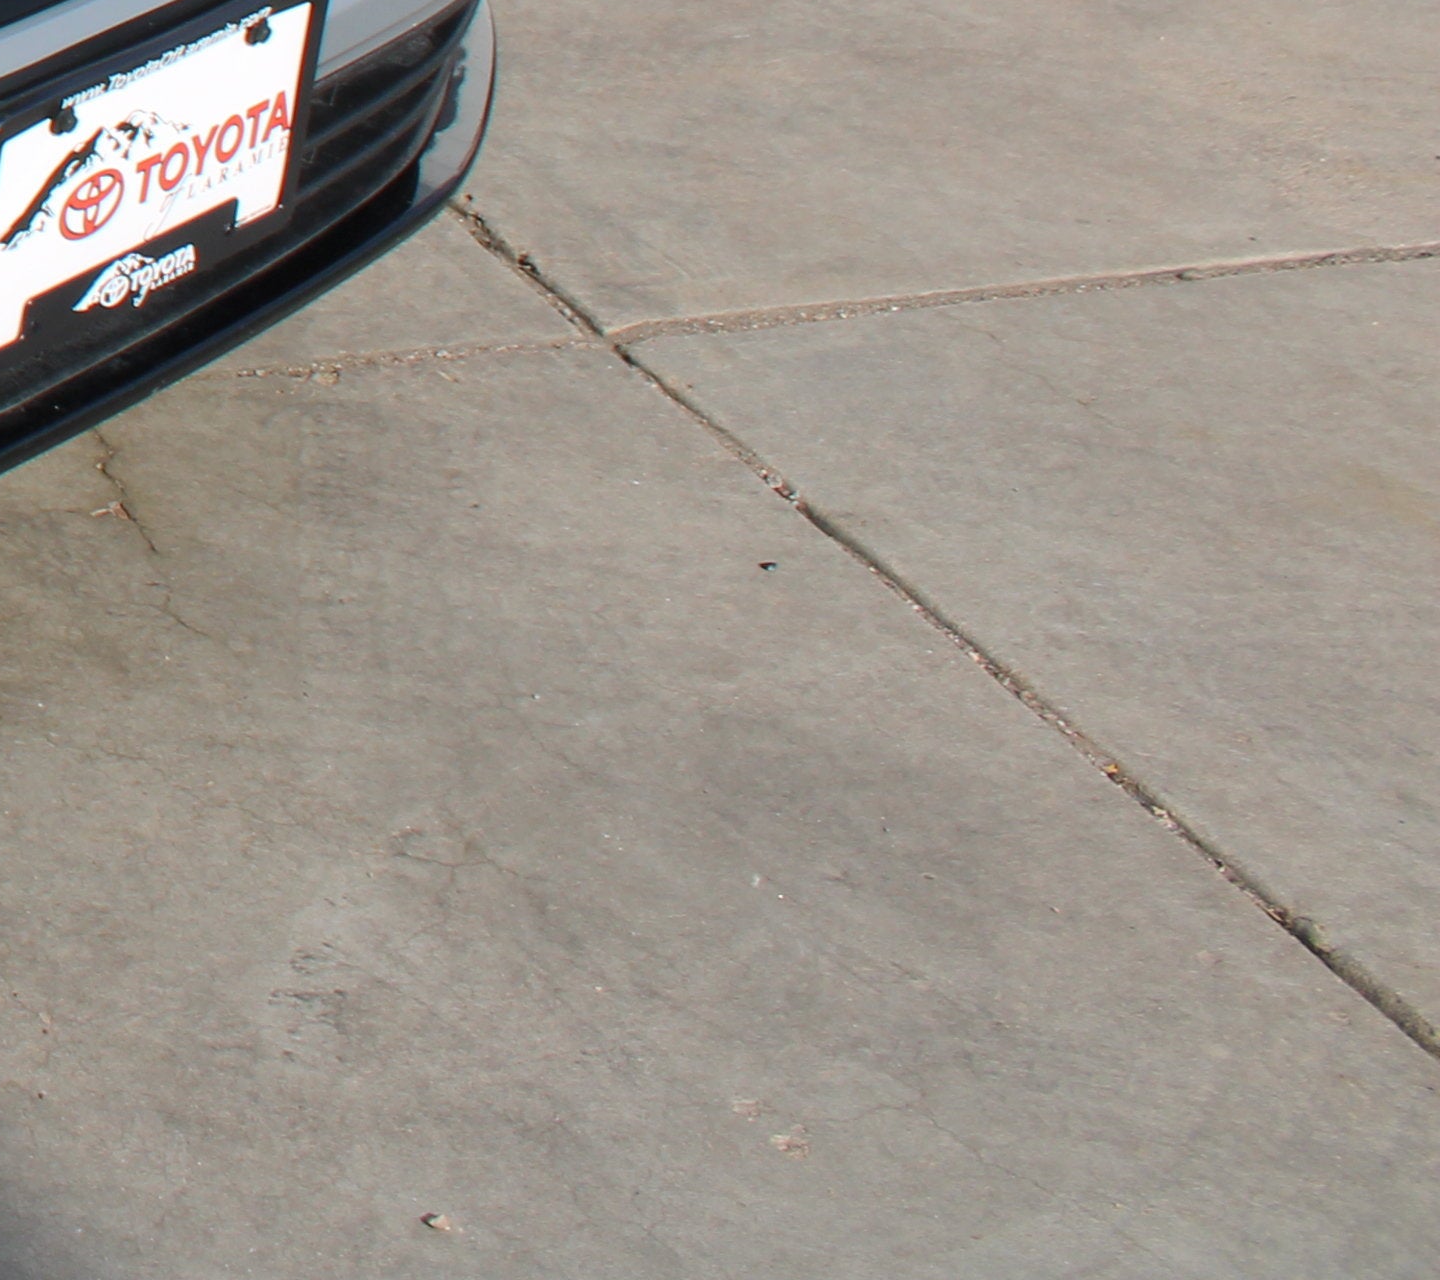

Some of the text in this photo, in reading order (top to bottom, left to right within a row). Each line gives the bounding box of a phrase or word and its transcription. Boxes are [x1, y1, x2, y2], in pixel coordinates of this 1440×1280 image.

[135, 90, 292, 205] TOYOTA
[186, 136, 289, 200] LARAMIE
[130, 243, 197, 292] TOYOTA
